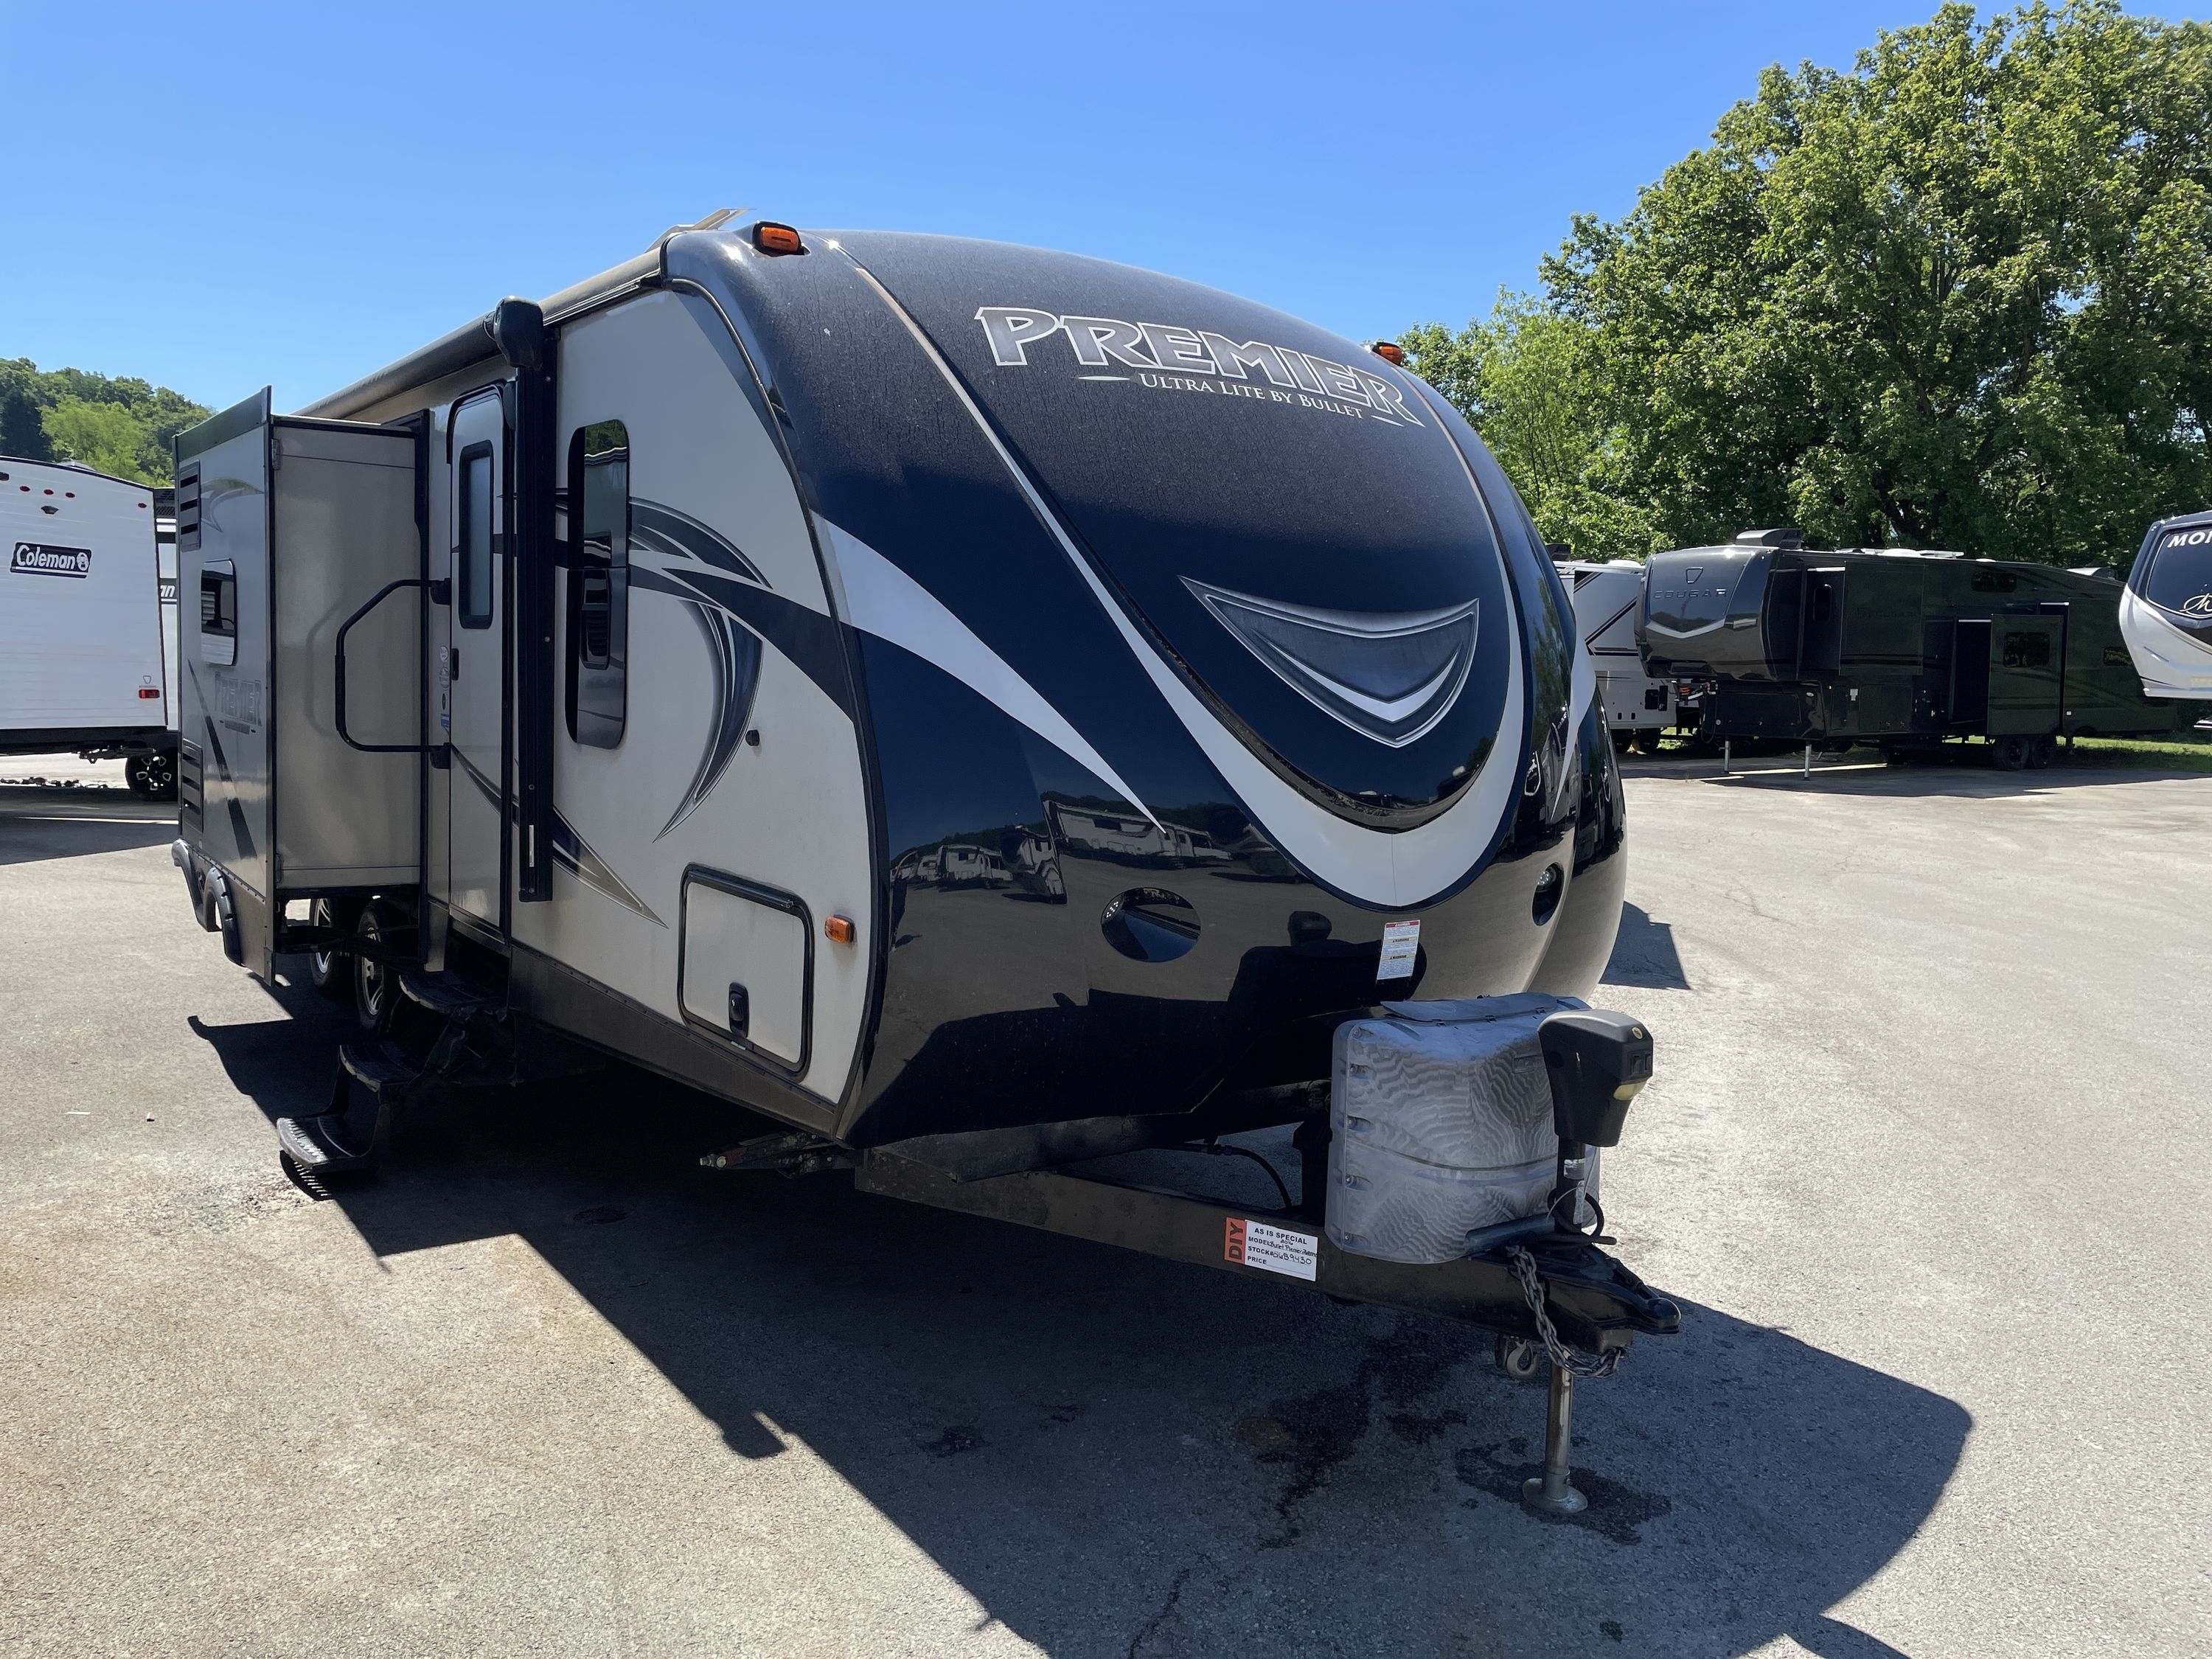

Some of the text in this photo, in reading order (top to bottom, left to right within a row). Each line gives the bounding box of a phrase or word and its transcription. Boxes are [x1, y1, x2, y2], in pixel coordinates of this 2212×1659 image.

[975, 307, 1425, 427] PREMIER
[1138, 373, 1363, 419] ULTRA LITE BY BULLET
[16, 544, 76, 570] Coleman
[1654, 588, 1727, 599] COUGAR
[1228, 1222, 1243, 1259] DIY
[1248, 1237, 1270, 1246] MODEL
[1276, 1232, 1307, 1245] SPECIAL
[1247, 1256, 1267, 1265] PRICE
